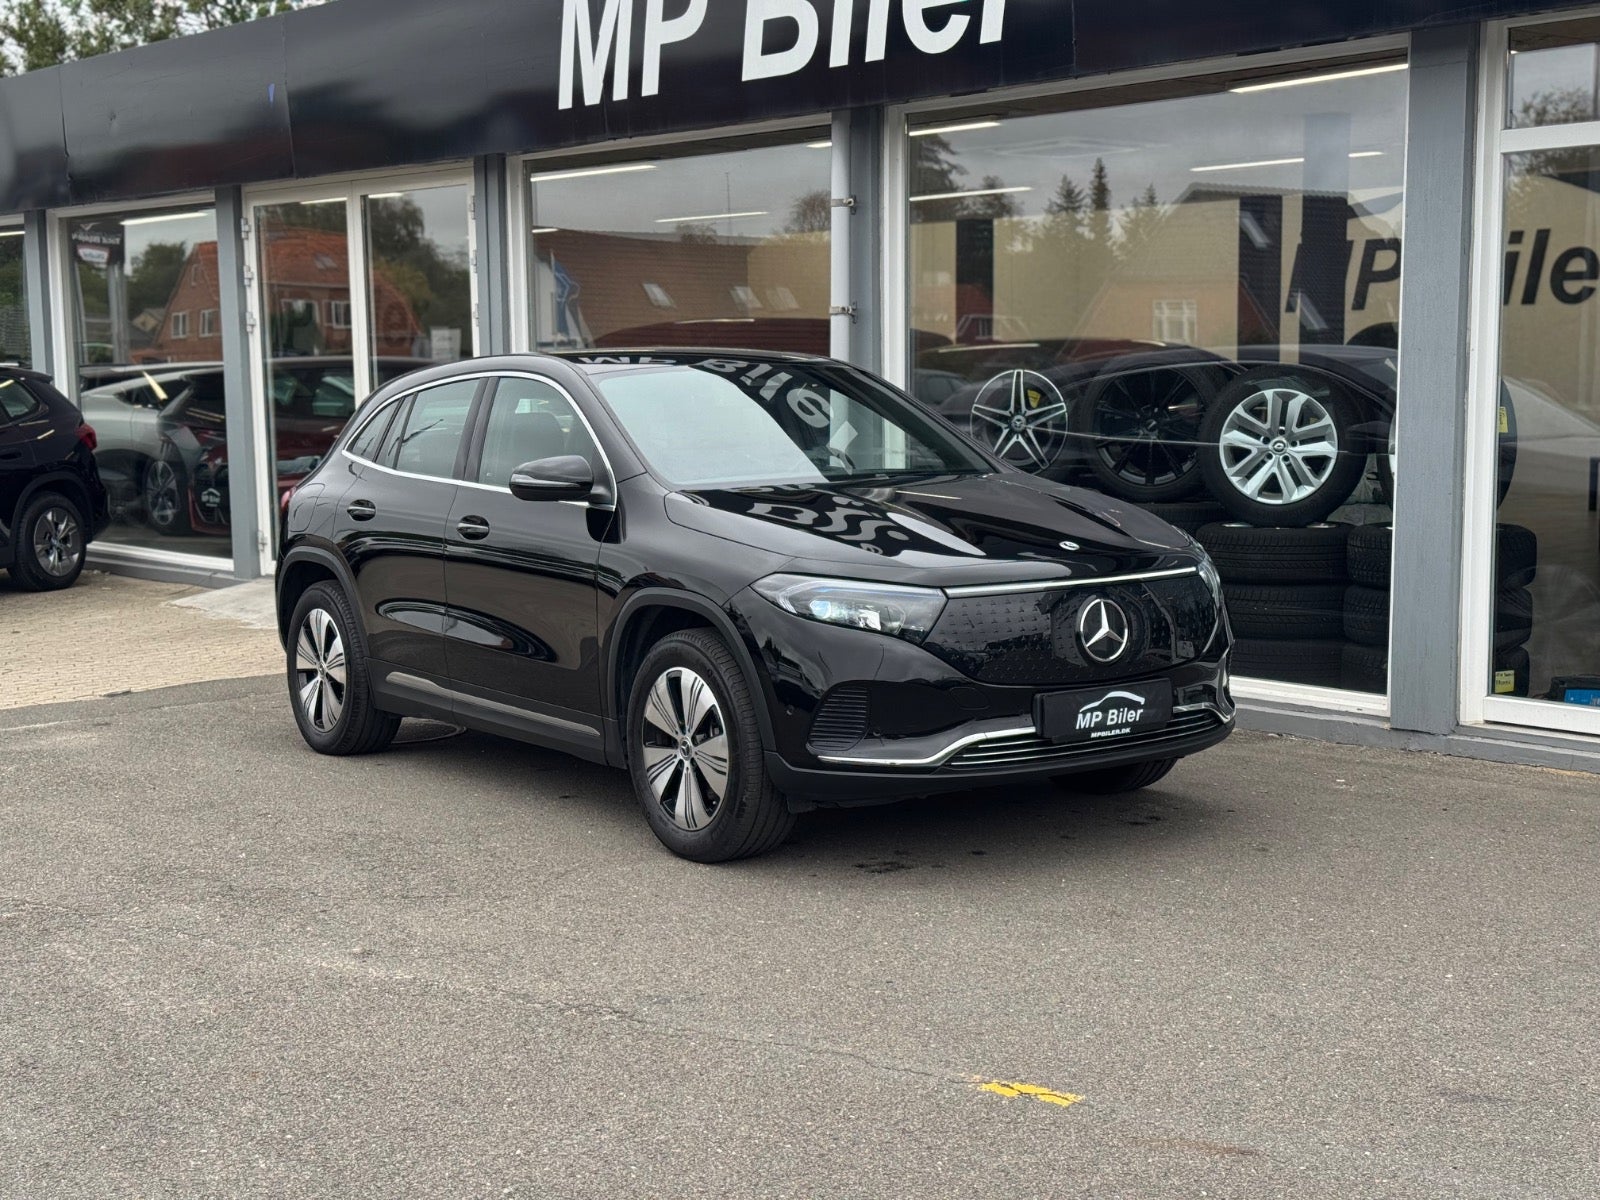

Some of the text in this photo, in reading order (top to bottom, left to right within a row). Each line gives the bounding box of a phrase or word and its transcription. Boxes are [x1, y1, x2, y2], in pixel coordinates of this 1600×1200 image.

[558, 0, 708, 110] MP
[1502, 228, 1599, 305] ile
[1075, 707, 1144, 729] MP Biler
[1090, 727, 1132, 738] MPBILER.DK
